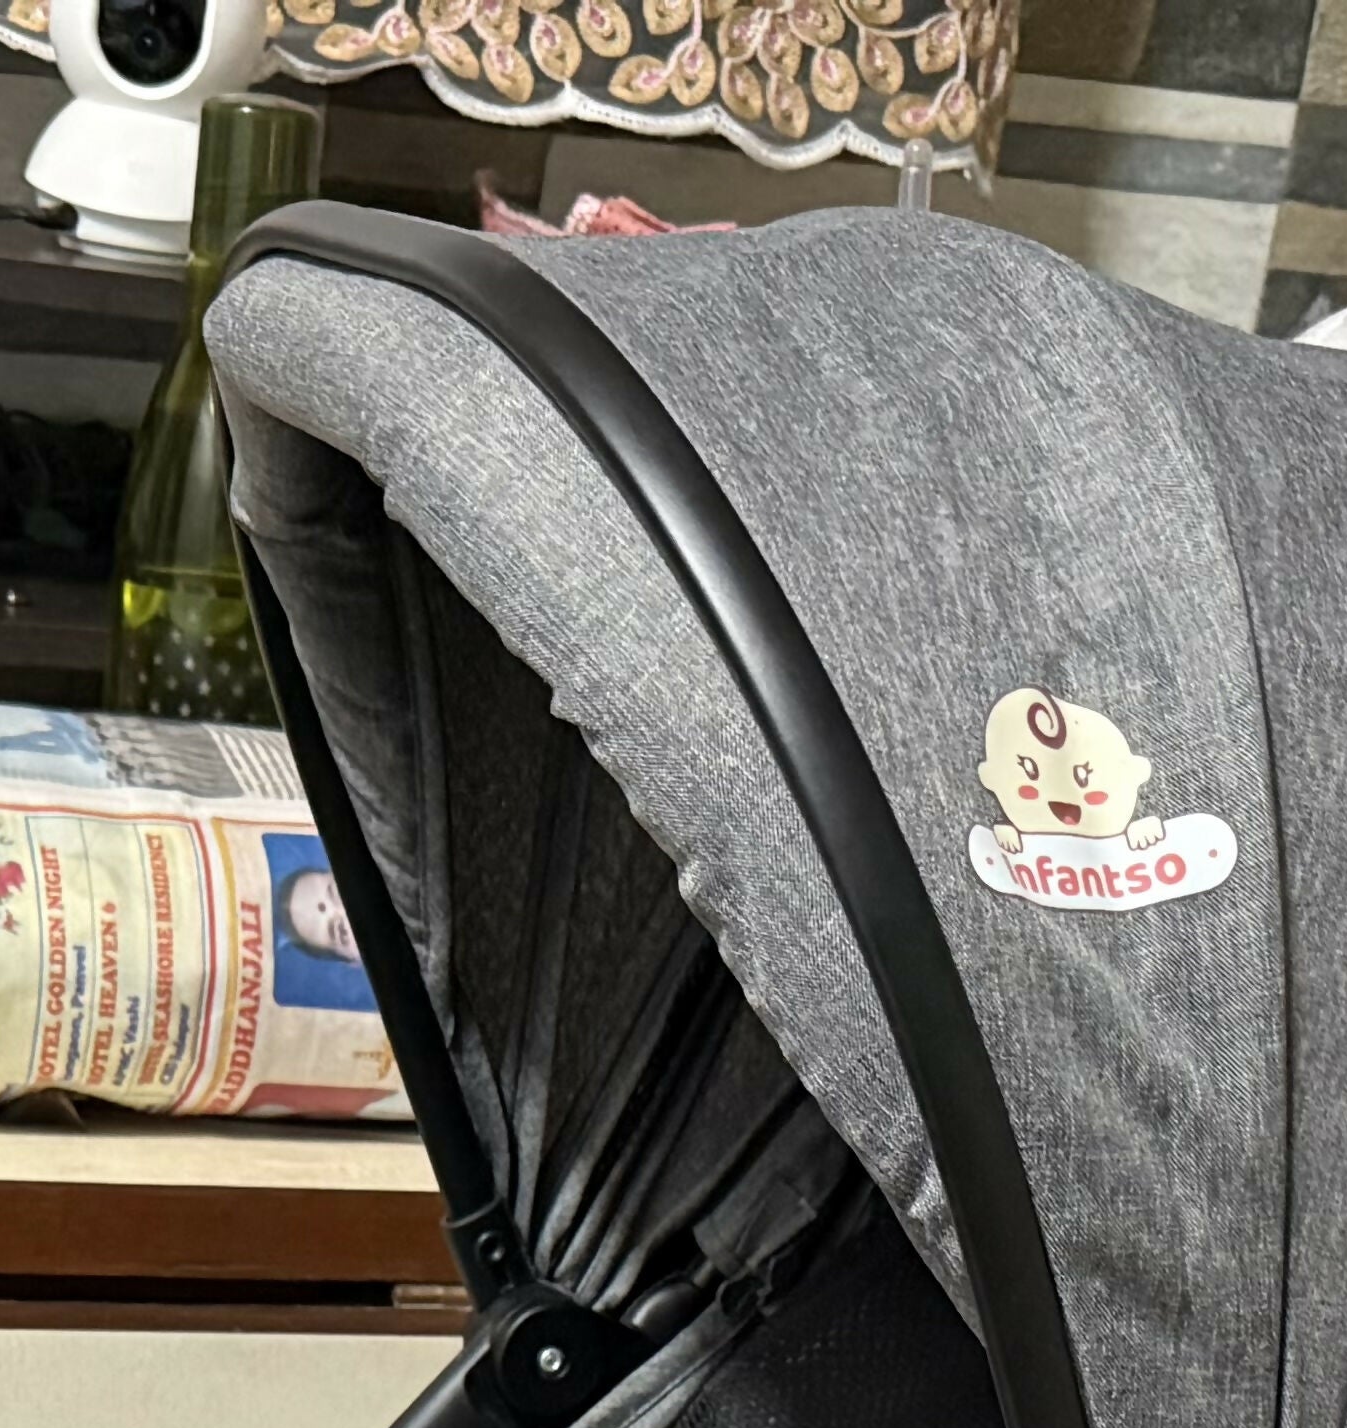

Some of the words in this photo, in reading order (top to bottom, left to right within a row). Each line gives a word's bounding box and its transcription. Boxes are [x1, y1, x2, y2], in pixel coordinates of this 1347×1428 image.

[40, 846, 64, 910] NIGHT
[146, 834, 173, 922] RESIDENCY
[44, 916, 66, 1016] GOLDEN
[98, 921, 118, 1018] HEAVEN
[152, 928, 174, 1042] SEASHORE
